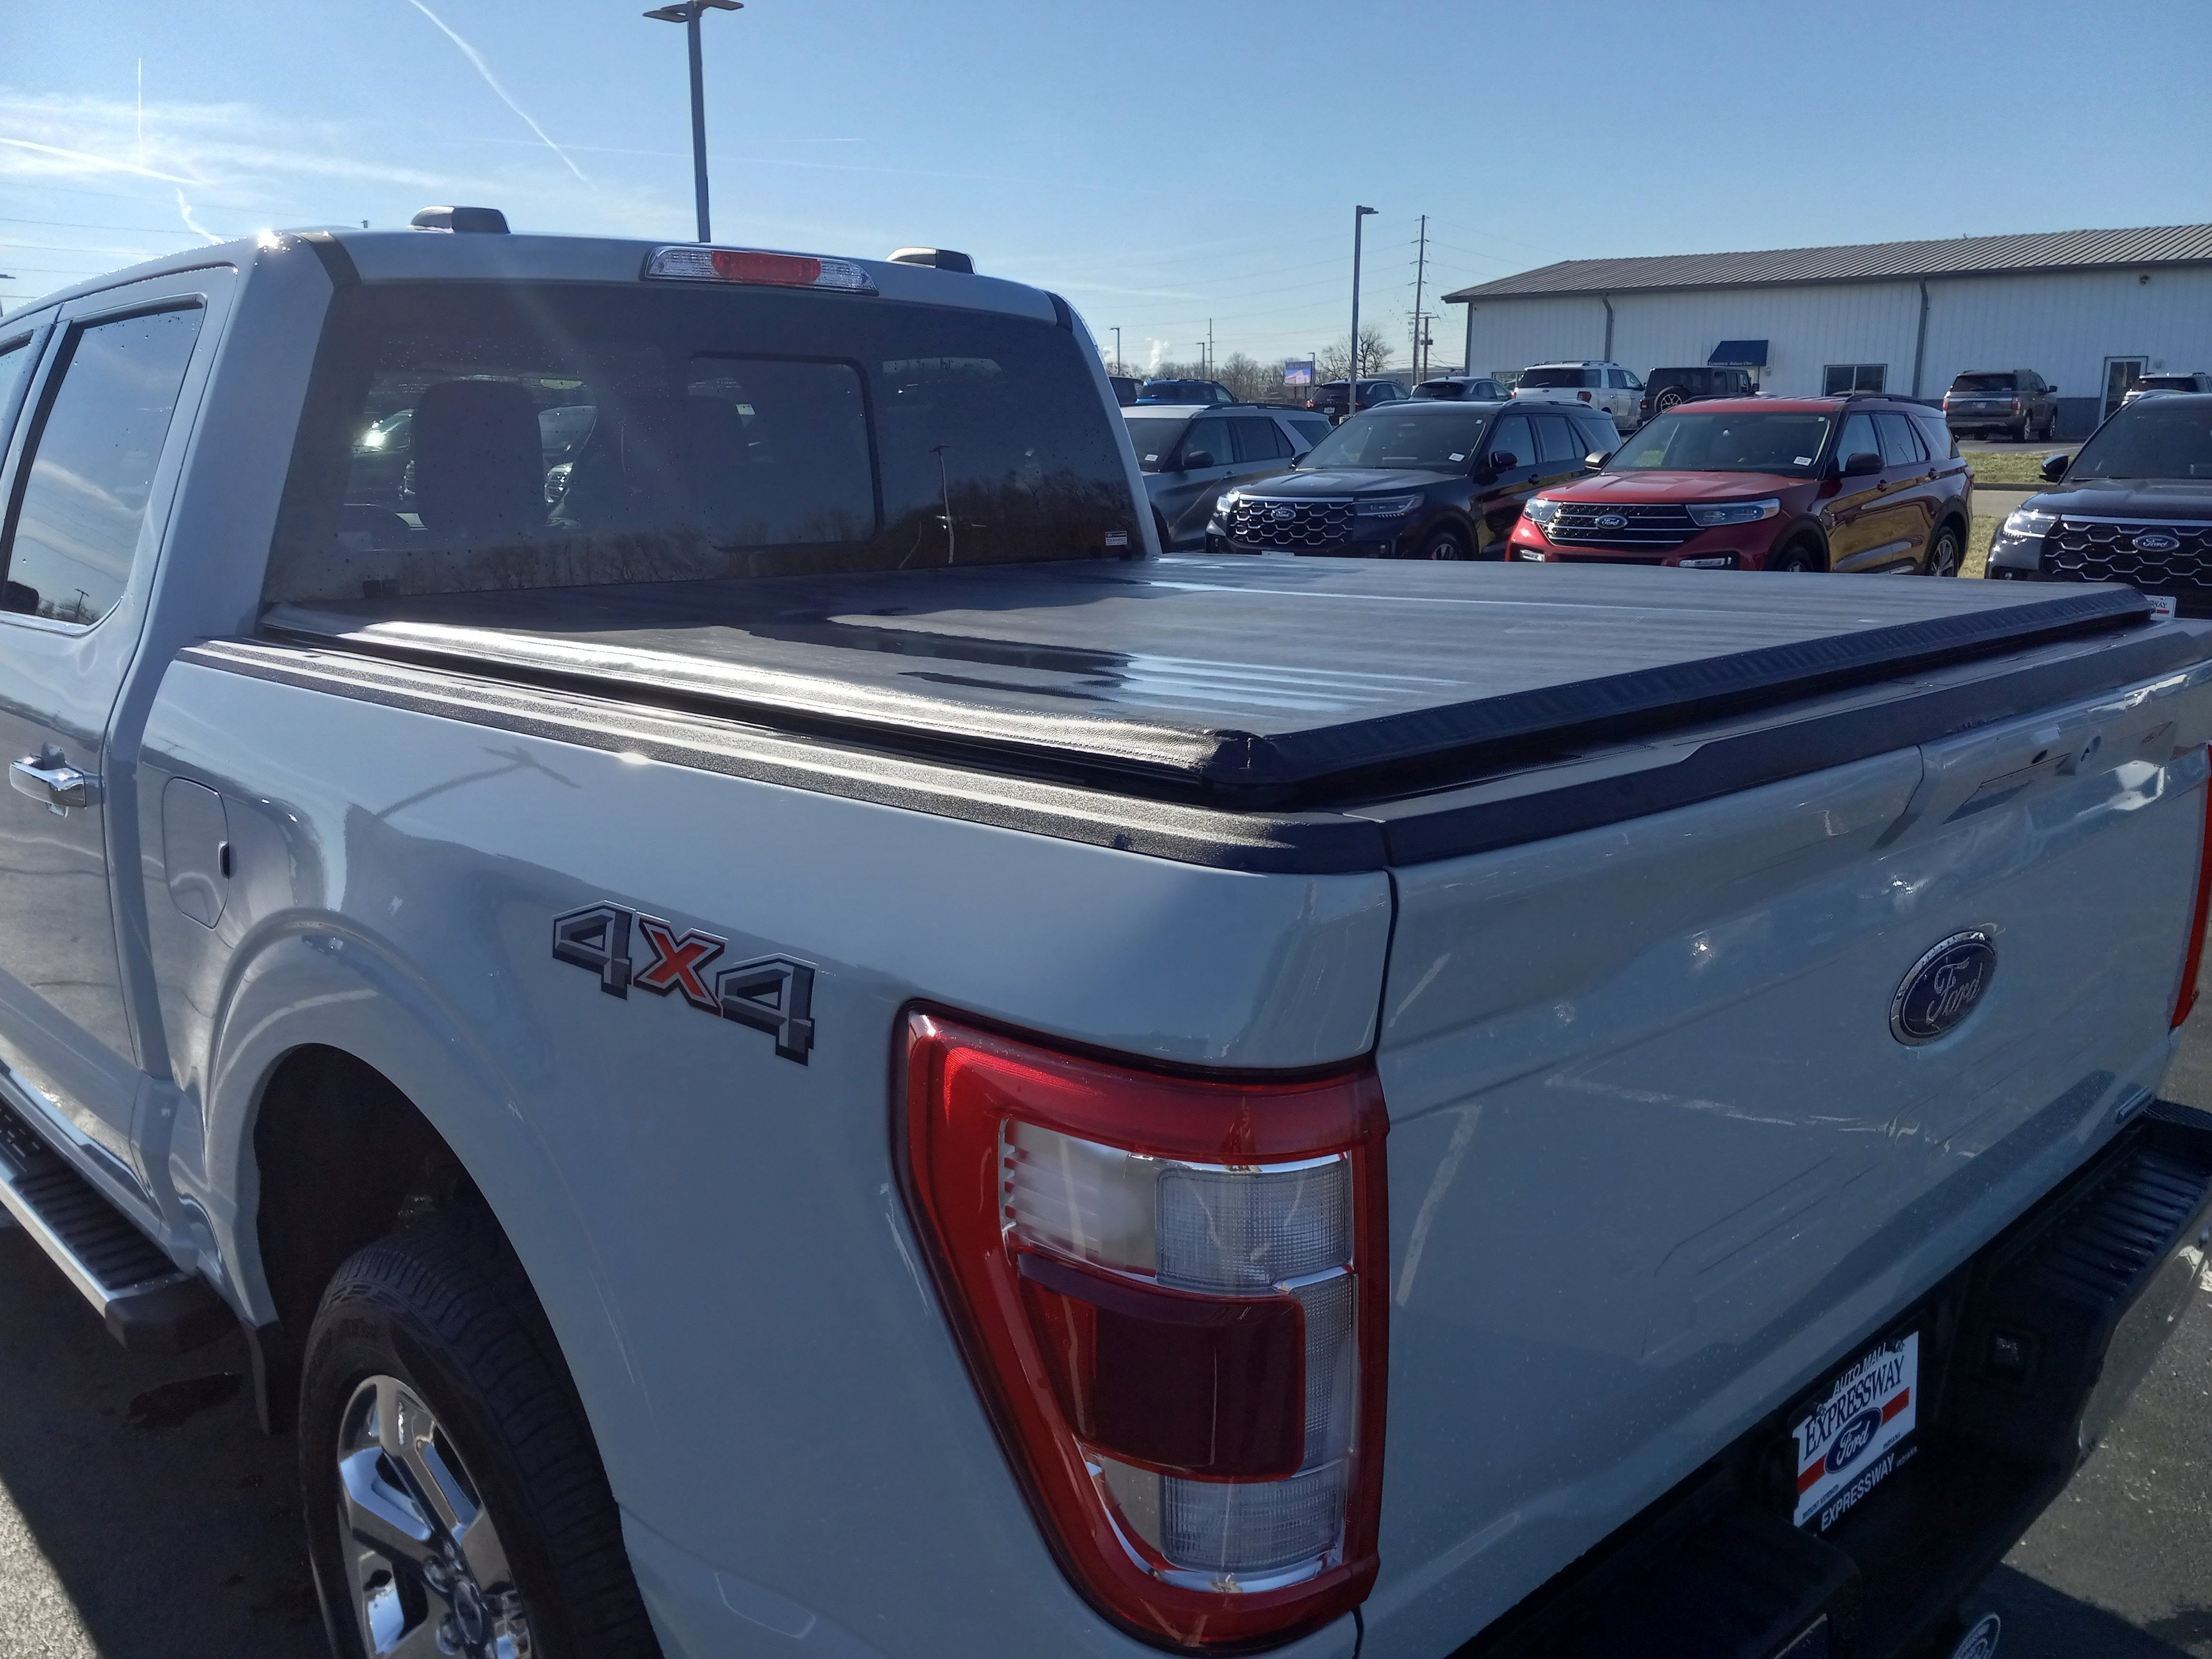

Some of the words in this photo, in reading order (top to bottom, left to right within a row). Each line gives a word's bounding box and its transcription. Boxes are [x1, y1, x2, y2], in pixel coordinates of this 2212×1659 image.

[1601, 517, 1620, 526] Ford
[2143, 538, 2168, 548] Ford
[1926, 956, 1983, 1025] Ford
[1832, 1364, 1861, 1395] AUTO
[1863, 1343, 1887, 1373] MALL
[1803, 1355, 1904, 1461] EXPRESSWAY
[1836, 1419, 1871, 1466] Ford
[1822, 1453, 1895, 1532] EXPRESSWAY
